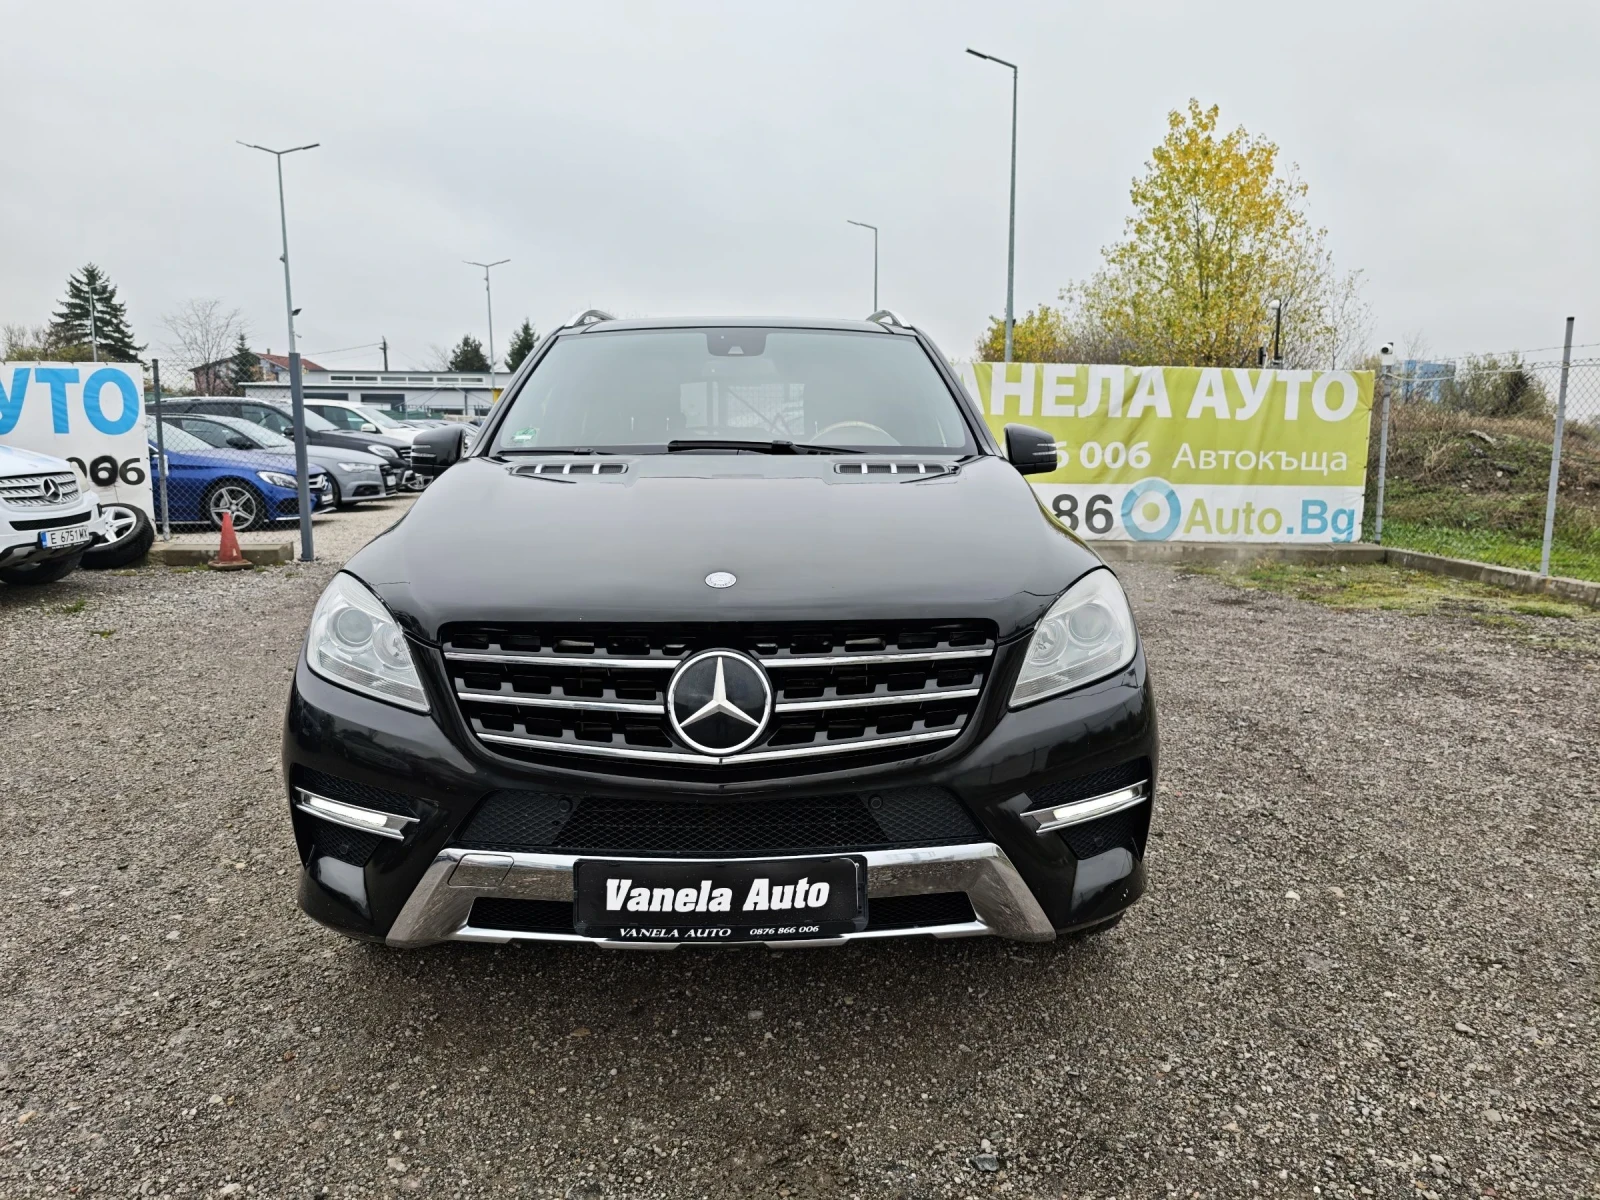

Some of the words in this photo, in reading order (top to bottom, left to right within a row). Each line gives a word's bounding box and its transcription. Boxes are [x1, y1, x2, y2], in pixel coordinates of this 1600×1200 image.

[0, 367, 140, 436] УТО
[1186, 368, 1359, 422] АУТО
[1079, 441, 1151, 470] 006
[1171, 443, 1348, 476] Автокъща
[1182, 498, 1356, 543] Auto.Bg
[50, 532, 57, 545] E
[606, 878, 733, 912] Vanela
[742, 877, 830, 911] Auto
[620, 928, 679, 938] VANELA
[684, 928, 732, 937] AUTO
[749, 927, 775, 935] 0876
[777, 926, 797, 934] 866
[798, 925, 820, 933] 006
